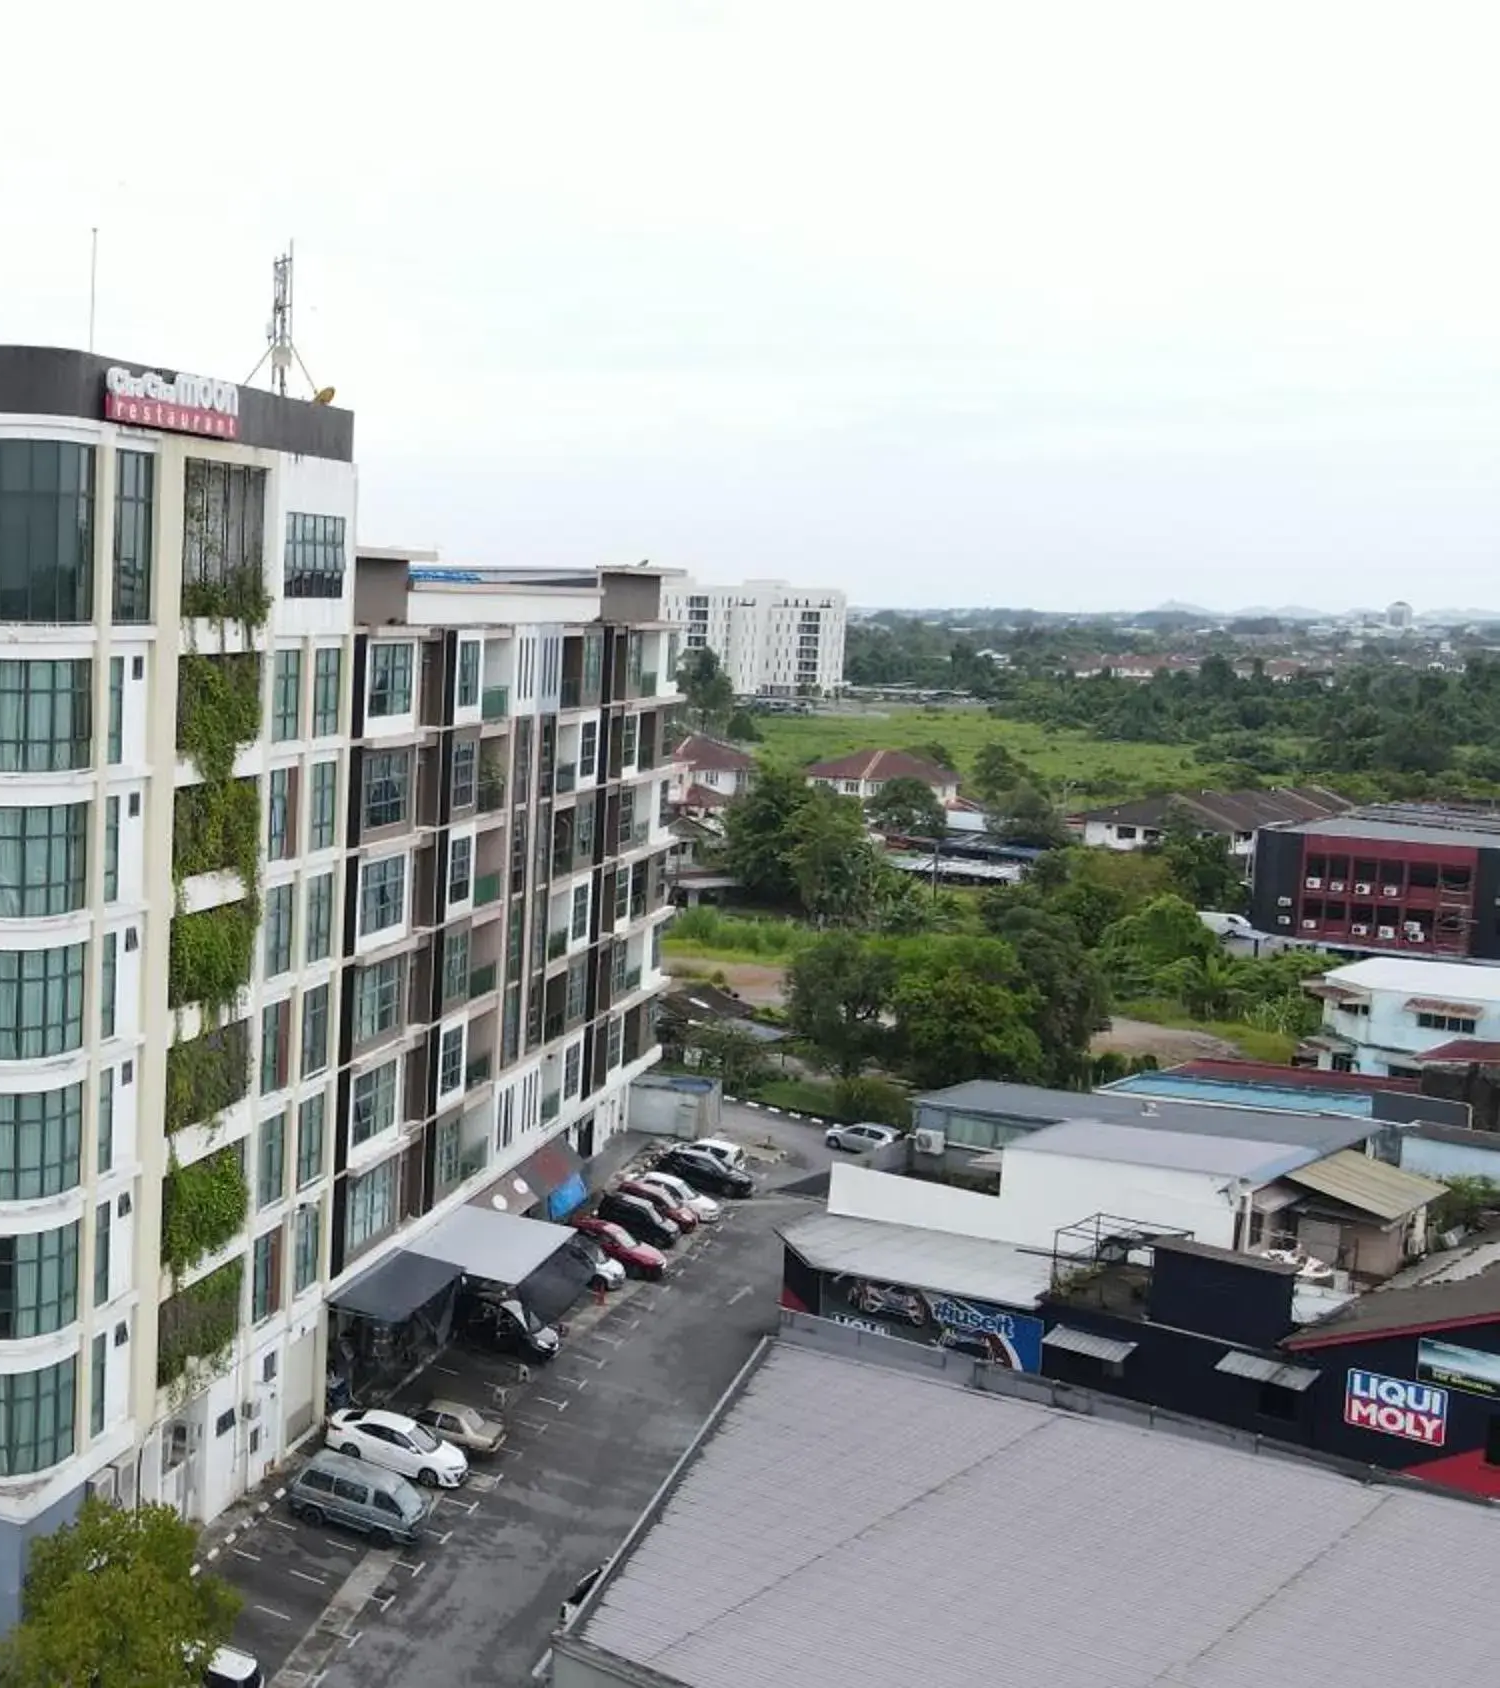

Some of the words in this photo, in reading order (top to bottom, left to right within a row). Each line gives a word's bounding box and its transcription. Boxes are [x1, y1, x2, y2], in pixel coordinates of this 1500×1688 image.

[116, 401, 236, 435] restaurant
[1353, 1373, 1441, 1414] LIQUI
[1351, 1400, 1442, 1439] MOLY
